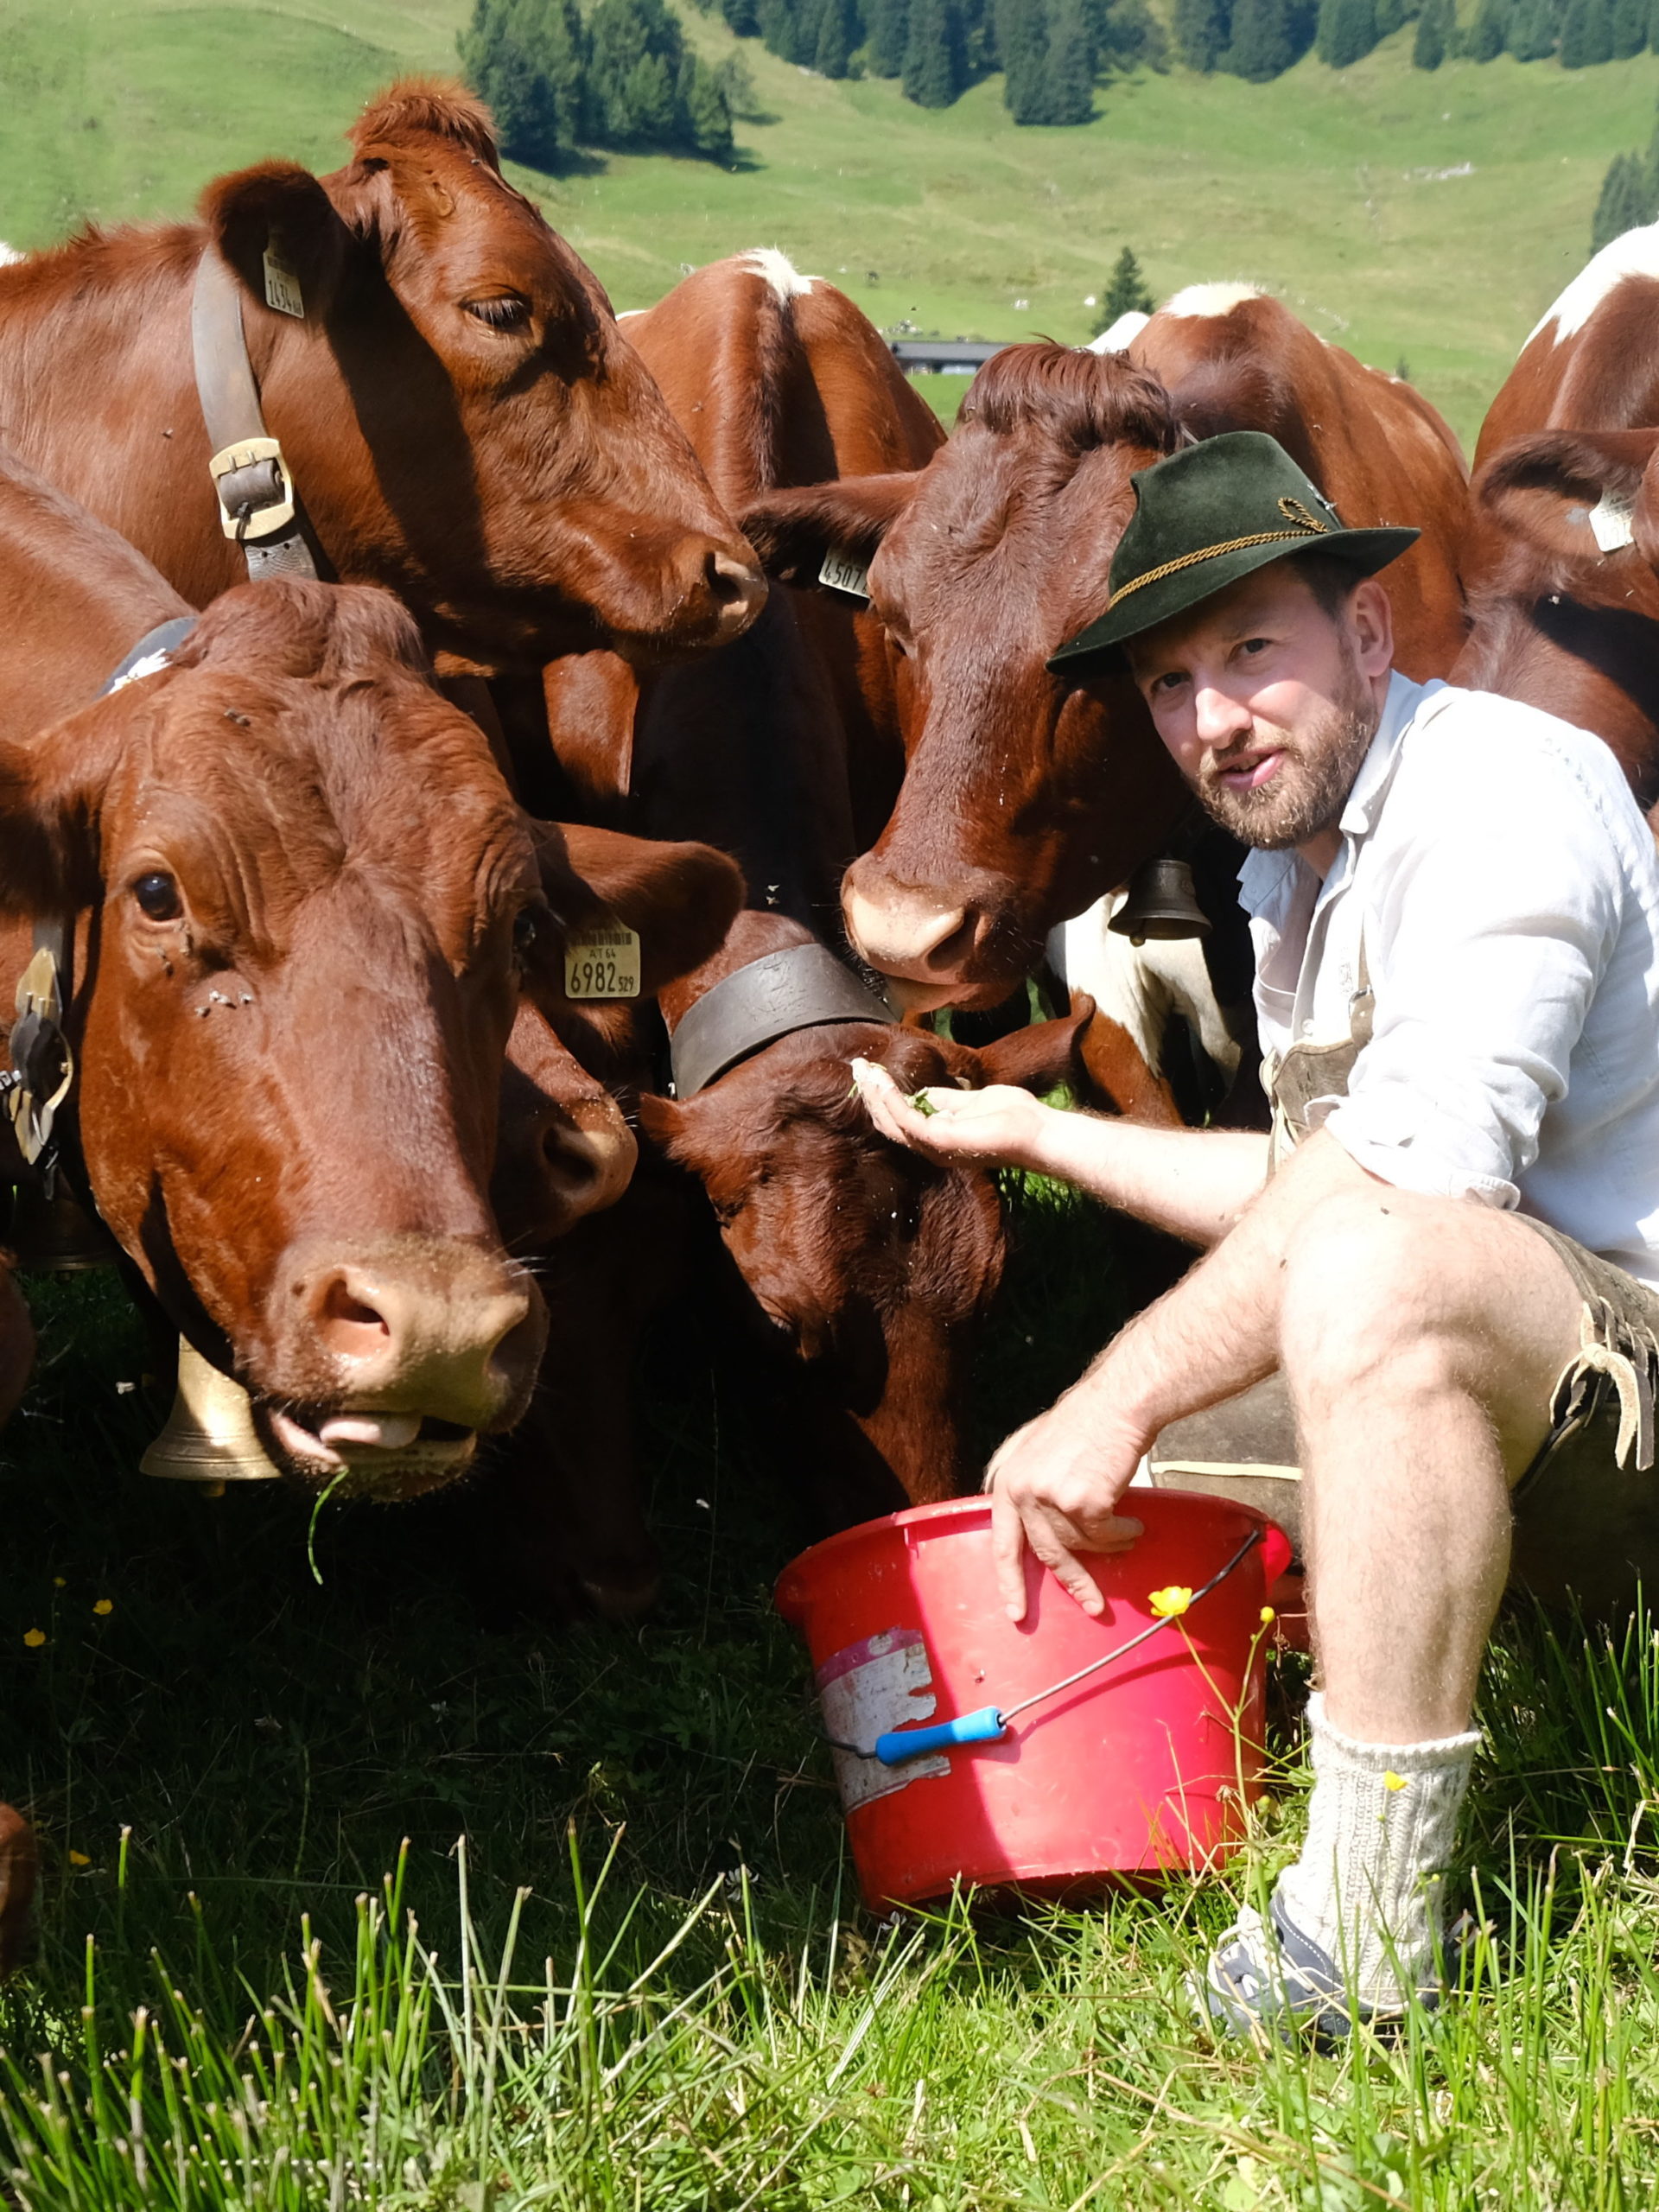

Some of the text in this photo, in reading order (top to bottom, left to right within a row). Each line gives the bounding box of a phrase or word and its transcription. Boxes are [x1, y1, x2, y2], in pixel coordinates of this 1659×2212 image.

[823, 559, 863, 590] 4507
[571, 962, 634, 993] 6982 529
